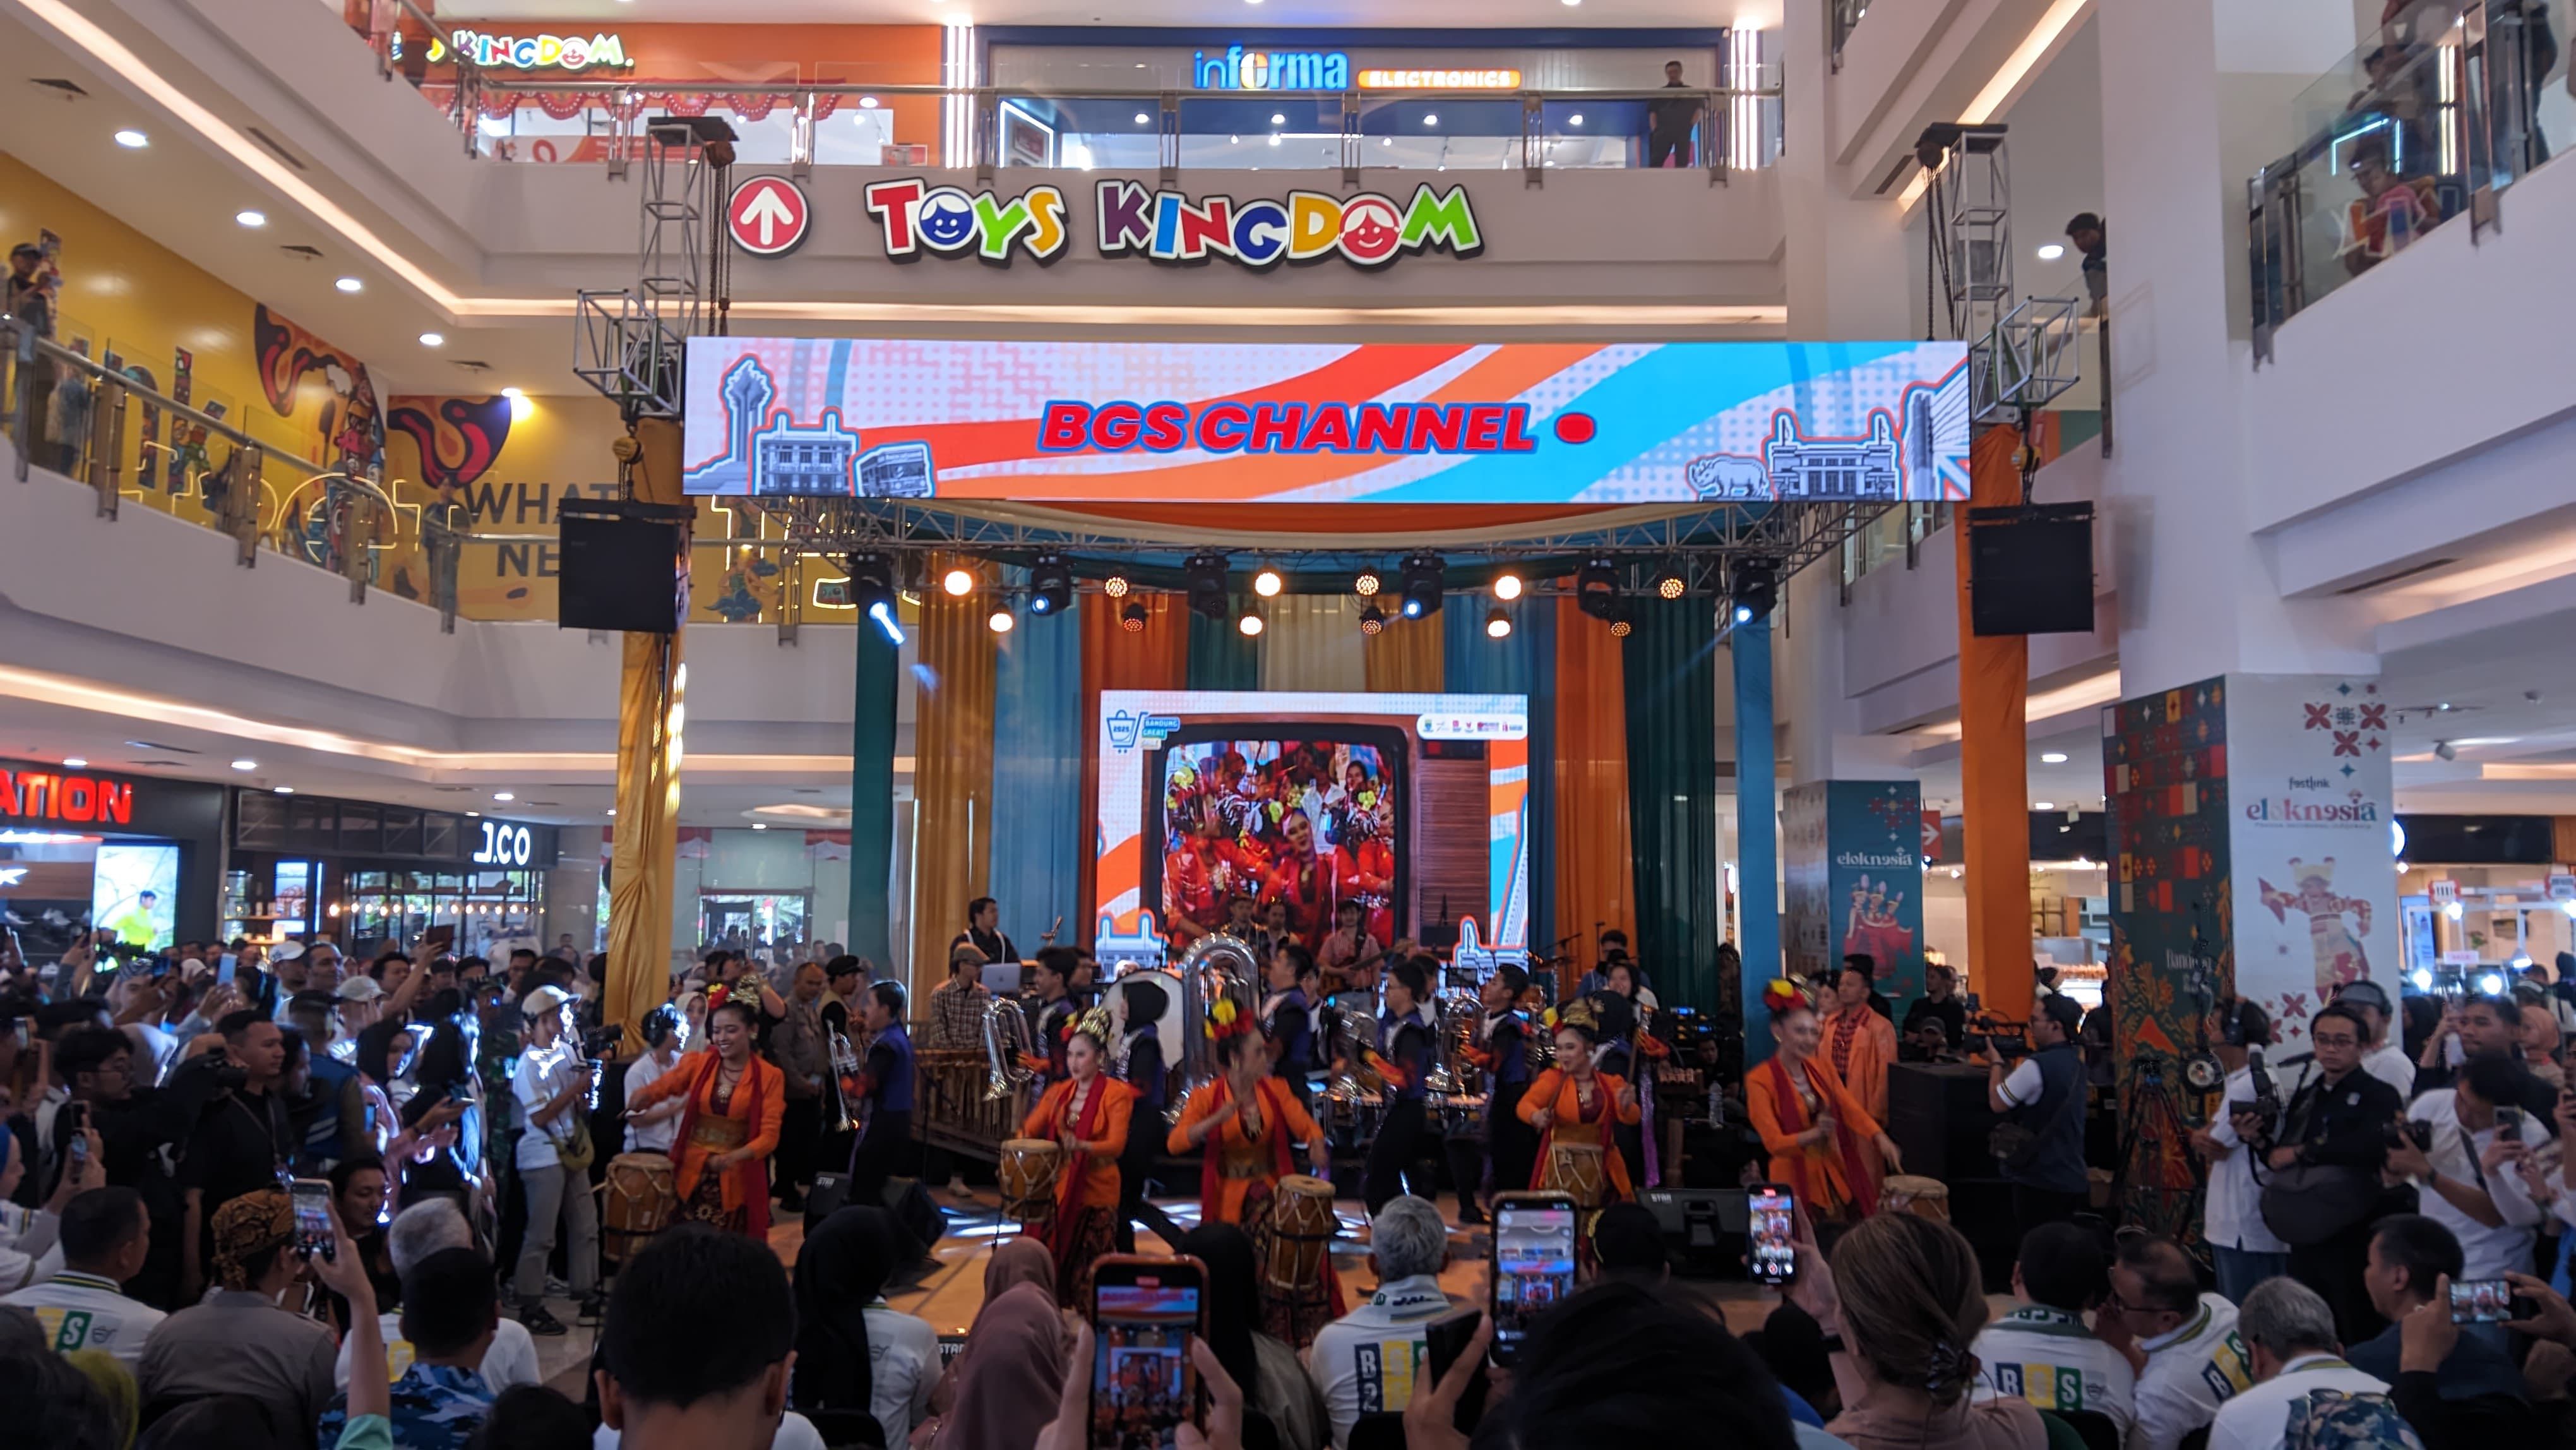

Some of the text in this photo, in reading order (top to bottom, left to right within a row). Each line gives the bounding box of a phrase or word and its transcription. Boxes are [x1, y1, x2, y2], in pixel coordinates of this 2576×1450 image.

[1193, 43, 1510, 90] informa ELECTRONICS
[866, 178, 1483, 267] TOYS KINGDOM
[1039, 400, 1538, 454] BGS CHANNEL
[473, 821, 530, 866] J.CO
